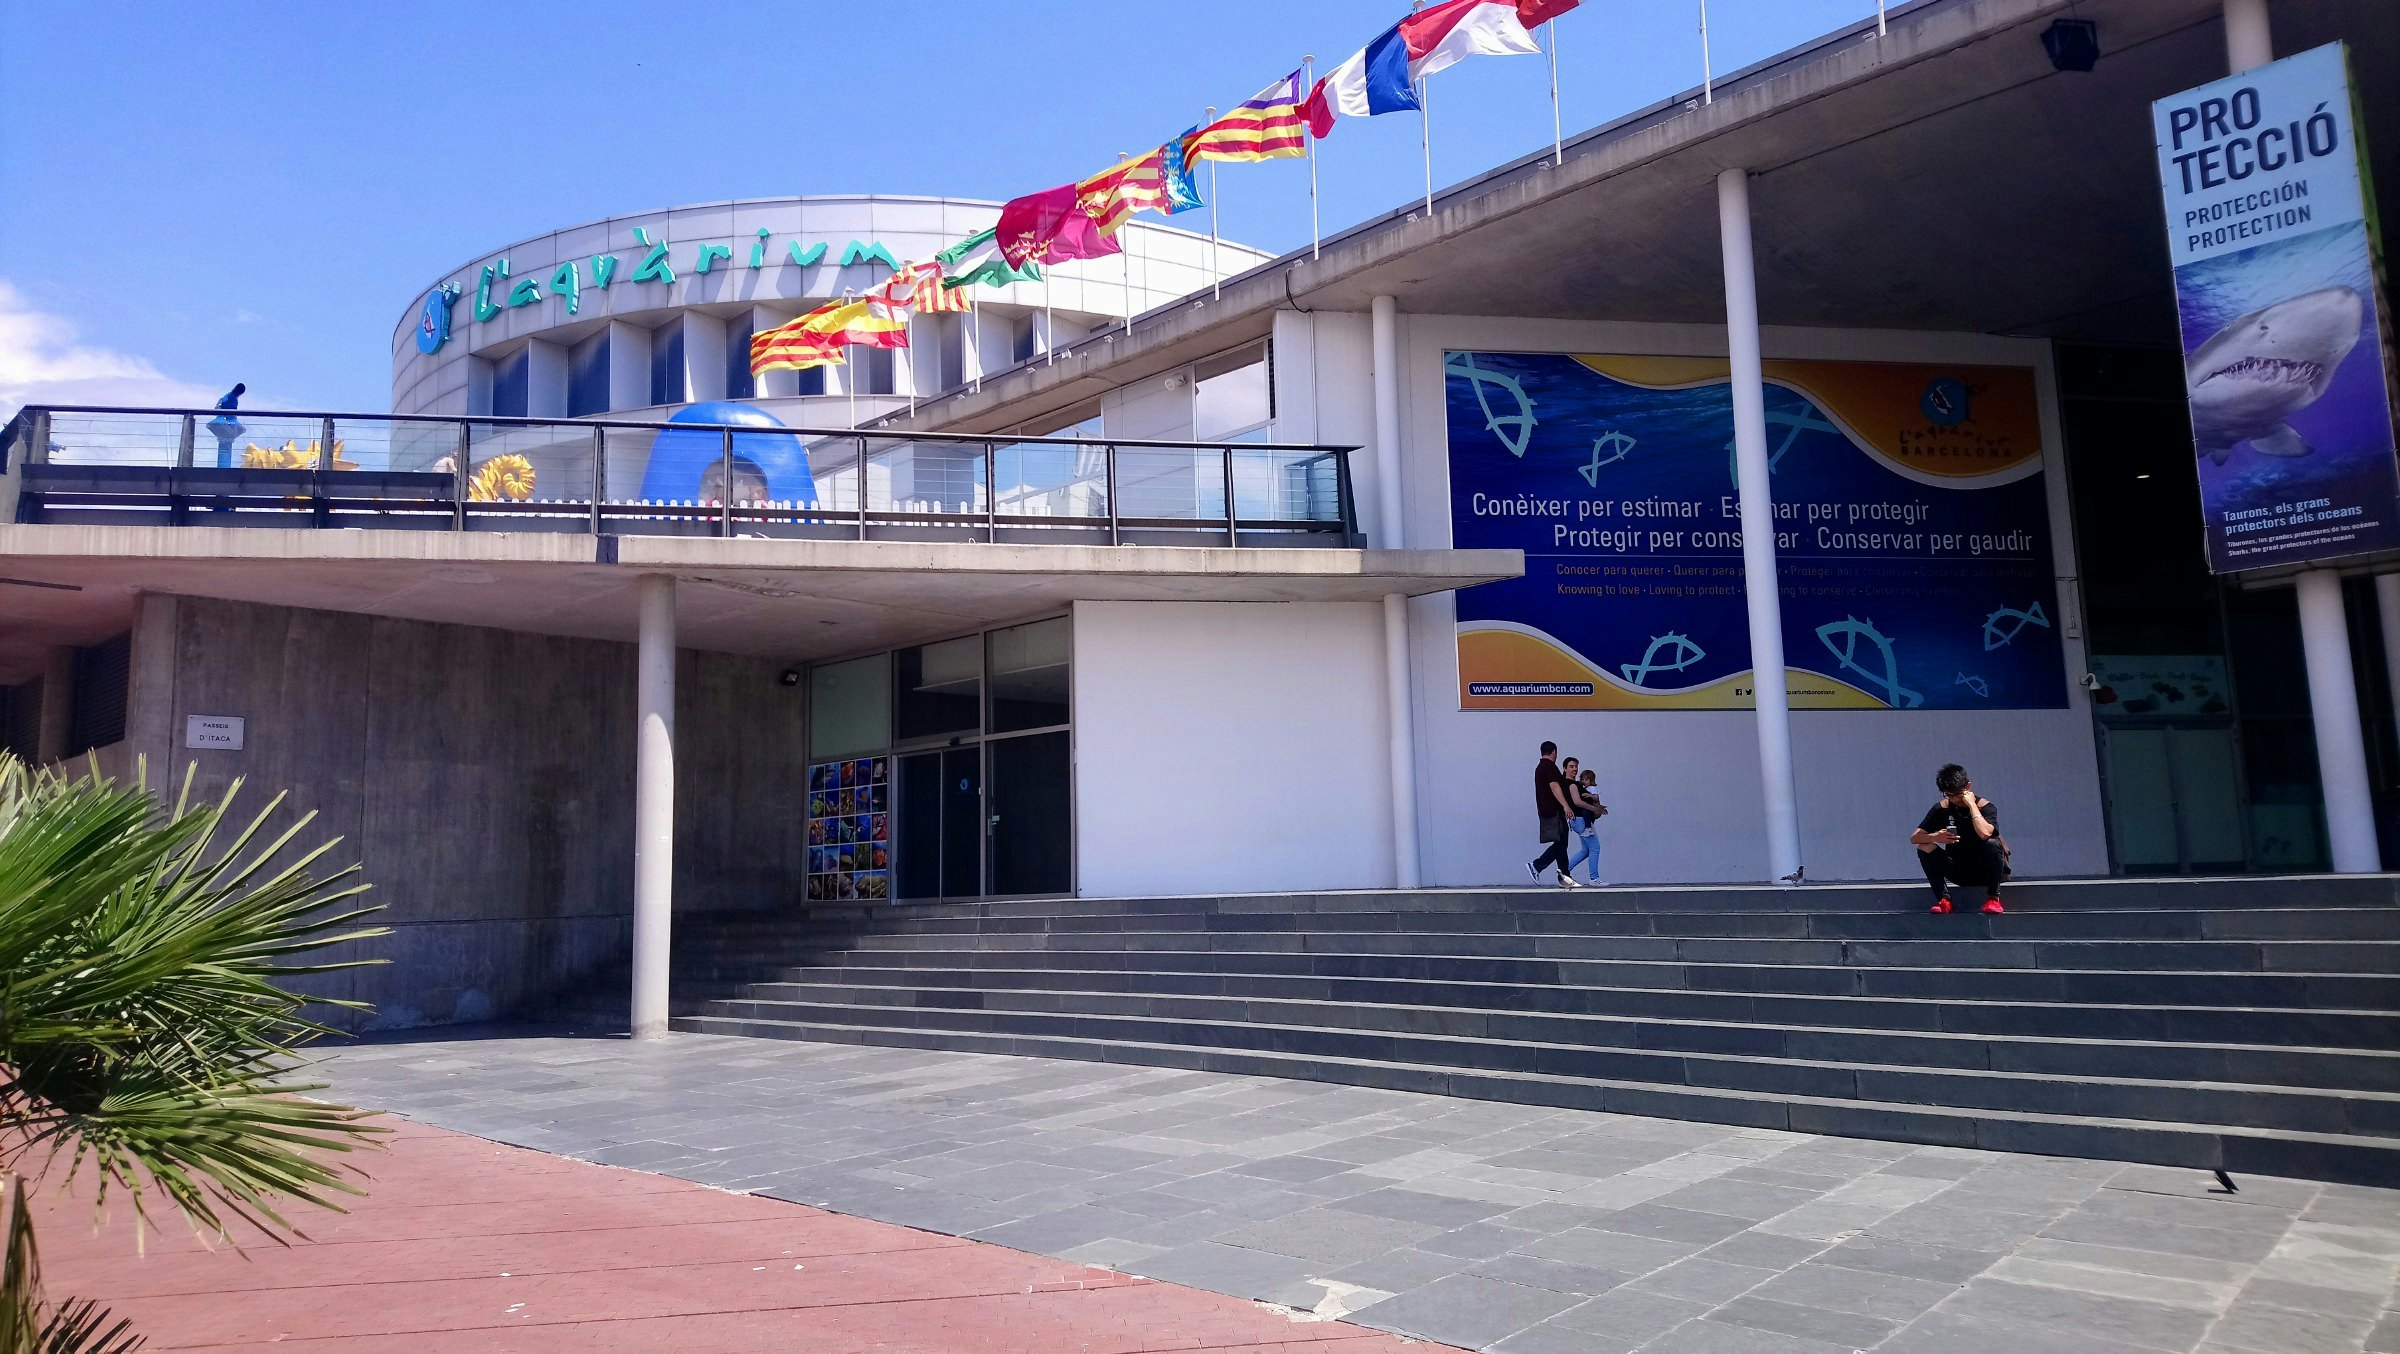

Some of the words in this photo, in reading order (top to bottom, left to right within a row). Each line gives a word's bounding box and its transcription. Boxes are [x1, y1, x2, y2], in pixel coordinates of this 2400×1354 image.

[2170, 87, 2262, 150] PRO
[2172, 101, 2339, 195] TECCIÓ
[2185, 179, 2309, 228] PROTECCIÓN
[2188, 204, 2312, 252] PROTECTION
[1901, 446, 2013, 458] BARCELONA
[1472, 493, 1571, 516] Conèixer
[1578, 500, 1614, 522] per
[1621, 496, 1702, 518] estimar
[1808, 502, 1841, 523] per
[1848, 499, 1929, 525] protegir
[2223, 507, 2272, 522] Taurons,
[2276, 502, 2293, 514] els
[2296, 498, 2330, 512] grans
[2225, 517, 2286, 536] protectors
[2290, 512, 2314, 524] dels
[2318, 506, 2363, 520] oceans
[1554, 524, 1642, 552] Protegir
[1650, 530, 1684, 552] per
[1817, 526, 1923, 550] Conservar
[1930, 533, 1963, 554] per
[1970, 530, 2032, 555] gaudir
[2262, 544, 2279, 552] great
[2280, 540, 2312, 550] protectors
[2269, 534, 2293, 542] grandes
[2294, 528, 2330, 540] protectores
[1556, 564, 1601, 576] Conocer
[1603, 566, 1628, 577] para
[1630, 566, 1665, 577] querer
[1673, 564, 1710, 576] Querer
[1712, 566, 1736, 578] para
[1557, 584, 1602, 596] Knowing
[1605, 584, 1616, 594] to
[1618, 584, 1640, 594] love
[1649, 584, 1682, 596] Loving
[1684, 585, 1695, 595] to
[1698, 584, 1736, 596] protect
[1472, 684, 1590, 694] www.aquariumbcn.com
